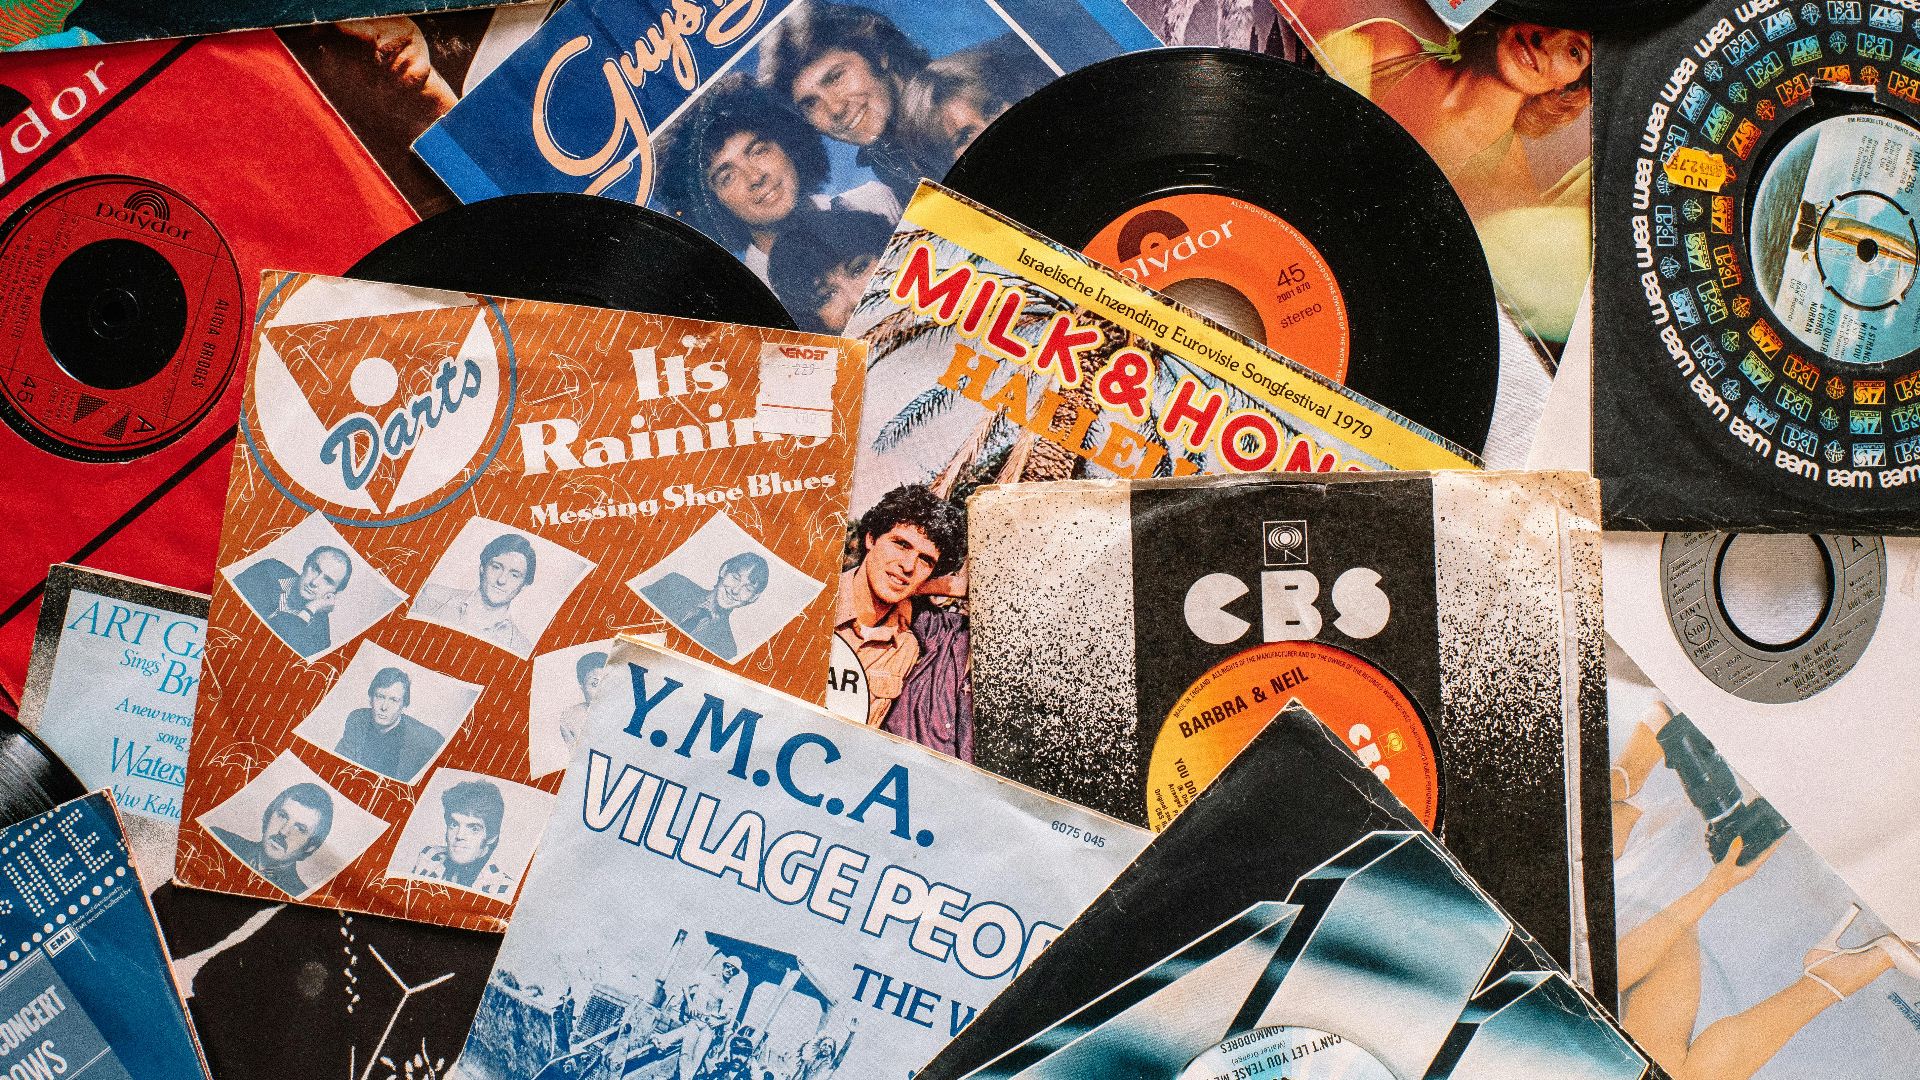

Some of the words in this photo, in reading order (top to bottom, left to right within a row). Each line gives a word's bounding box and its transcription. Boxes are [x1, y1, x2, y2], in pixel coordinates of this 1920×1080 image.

[532, 0, 706, 207] Guys
[1, 59, 110, 178] dor
[1684, 174, 1708, 188] NU
[1905, 175, 1917, 194] 285
[1230, 200, 1244, 208] ALL
[1242, 204, 1270, 220] RIGHTS
[96, 203, 192, 241] Polydor
[1267, 215, 1277, 224] OF
[1276, 221, 1289, 232] THE
[1119, 219, 1233, 282] olydor
[1287, 229, 1317, 260] PRODUCER
[1277, 263, 1306, 287] 45
[1314, 259, 1325, 273] AND
[1276, 290, 1296, 304] 2001
[1296, 282, 1311, 296] 870
[206, 298, 229, 337] ALICIA
[1280, 302, 1322, 329] stereo
[1332, 295, 1343, 321] OWNER
[1803, 301, 1818, 333] NORMAN
[1825, 308, 1837, 325] SUZI
[1338, 321, 1345, 330] OF
[1813, 312, 1826, 335] CHRIS
[1857, 321, 1868, 340] WITH
[1016, 246, 1096, 297] Israelische
[1096, 285, 1169, 338] Inzending
[1170, 322, 1240, 373] Eurovisie
[1242, 359, 1333, 420] Songfestival
[1332, 408, 1374, 439] 1979
[1852, 343, 1863, 359] YOU
[1861, 332, 1876, 364] STRANG
[190, 340, 217, 389] BRIDGES
[892, 242, 1102, 391] MILK
[1097, 351, 1153, 419] &
[1163, 379, 1370, 473] HON
[1337, 347, 1345, 367] WORK
[17, 377, 37, 405] 45
[133, 413, 156, 434] A
[320, 357, 482, 491] Darts
[515, 403, 829, 477] Rainin
[530, 498, 660, 529] Messing
[662, 481, 744, 511] Shoe
[746, 471, 837, 499] Blues
[1852, 538, 1863, 551] A
[1184, 567, 1390, 644] CBS
[67, 600, 160, 646] ART
[163, 621, 204, 660] G
[1685, 621, 1708, 638] STOP
[120, 648, 161, 677] Sings
[1725, 654, 1742, 668] 1979
[1792, 670, 1817, 688] VILLAGE
[1816, 654, 1840, 672] PEOPLE
[828, 667, 861, 695] AR
[1172, 701, 1186, 718] MADE
[1183, 695, 1192, 705] IN
[1188, 676, 1211, 699] ENGLAND
[1210, 669, 1222, 680] ALL
[1237, 657, 1245, 666] OF
[1245, 654, 1255, 664] THE
[1298, 649, 1309, 657] AND
[115, 697, 130, 713] A
[132, 705, 160, 720] new
[1179, 696, 1249, 738] BARBRA
[1253, 687, 1267, 703] &
[1270, 666, 1309, 695] NEIL
[156, 731, 187, 748] song
[111, 737, 186, 784] Waters
[623, 662, 935, 848] Y.M.C.A.
[1173, 757, 1190, 779] YOU
[1152, 788, 1169, 811] Original
[1166, 782, 1184, 808] Arranged
[1154, 807, 1165, 820] CBS
[582, 749, 869, 923] VILLAGE
[1051, 819, 1081, 841] 6075
[1083, 828, 1106, 849] 045
[50, 931, 71, 951] EMI
[851, 963, 941, 1028] THE
[0, 985, 65, 1056] CONCERT
[1220, 1025, 1284, 1053] COMMODORES
[1291, 1044, 1310, 1060] LET
[1313, 1033, 1341, 1053] CAN'T
[1232, 1063, 1265, 1080] TEASE
[1267, 1054, 1289, 1069] YOU
